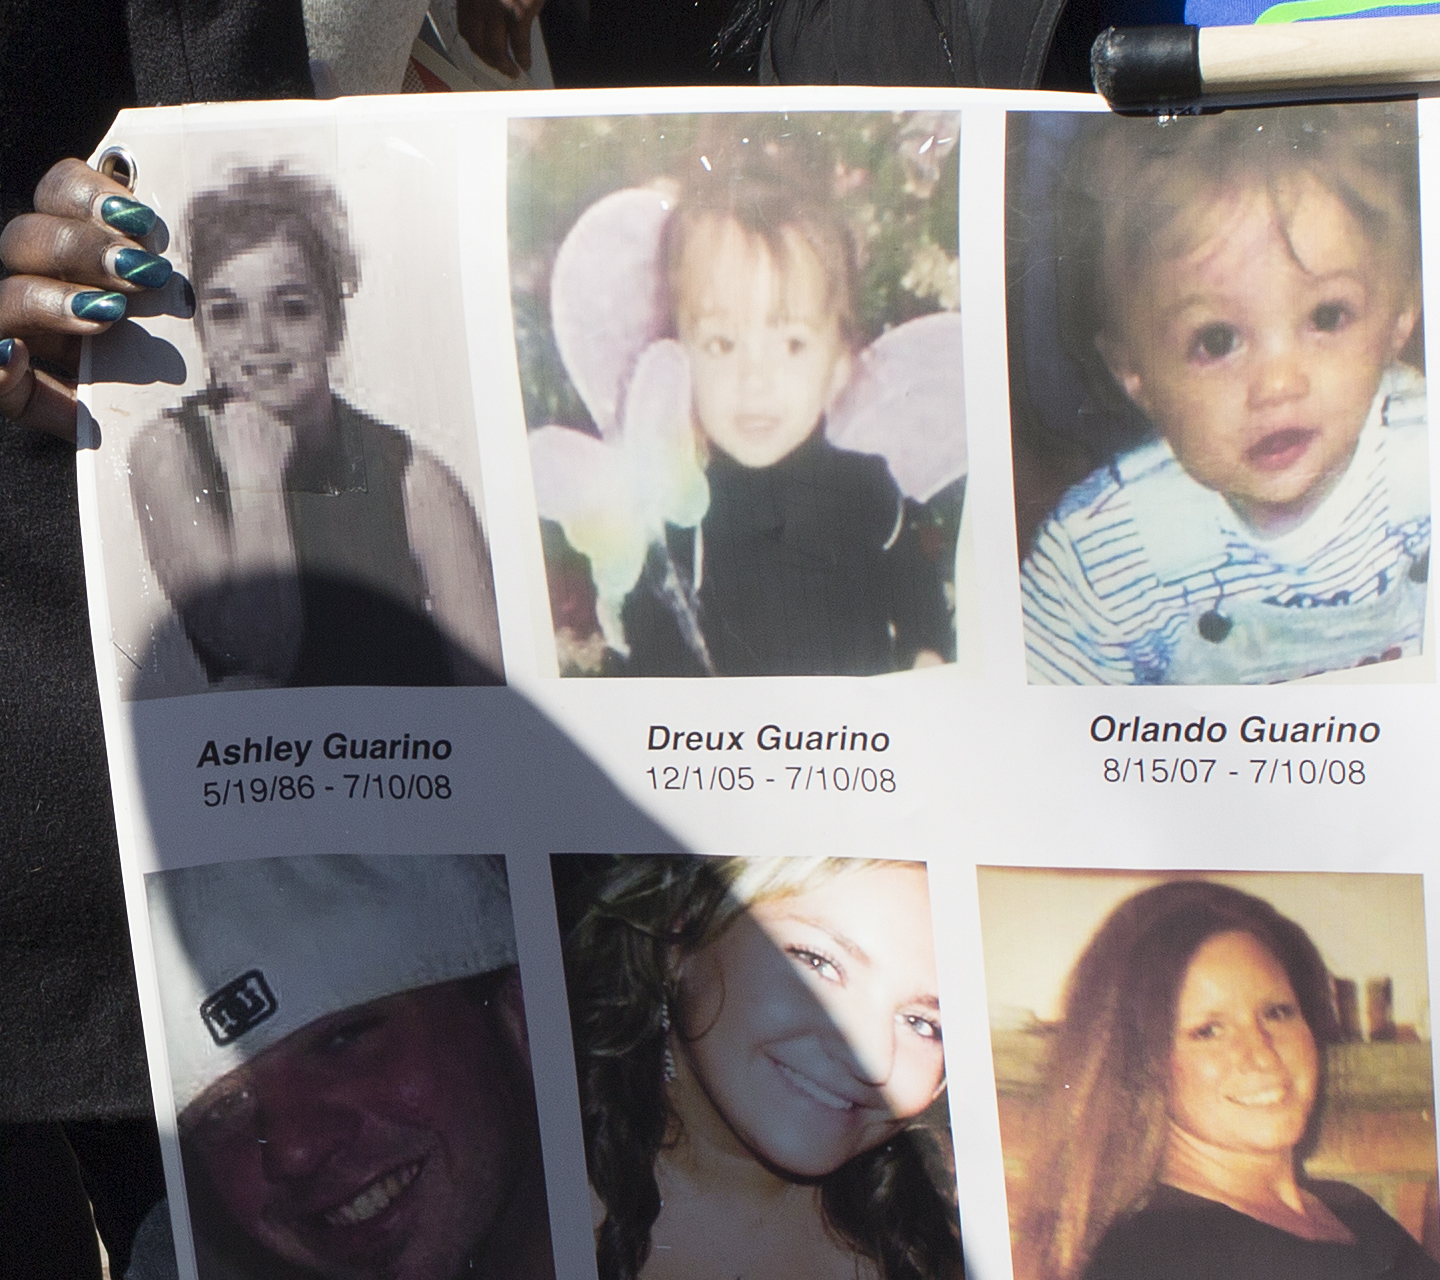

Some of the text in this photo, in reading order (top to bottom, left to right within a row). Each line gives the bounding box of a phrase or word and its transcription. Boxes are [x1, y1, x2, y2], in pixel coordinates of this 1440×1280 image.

[647, 724, 890, 753] Dreux Guarino
[1090, 714, 1381, 744] Orlando Guarino
[196, 732, 453, 769] Ashley Guarino
[647, 766, 755, 791] 12/1/05
[785, 766, 896, 793] 7/10/08
[1103, 758, 1217, 784] 8/15/07
[1249, 759, 1366, 785] 7/10/08
[203, 774, 316, 808] 5/19/86
[343, 773, 453, 800] 7/10/08
